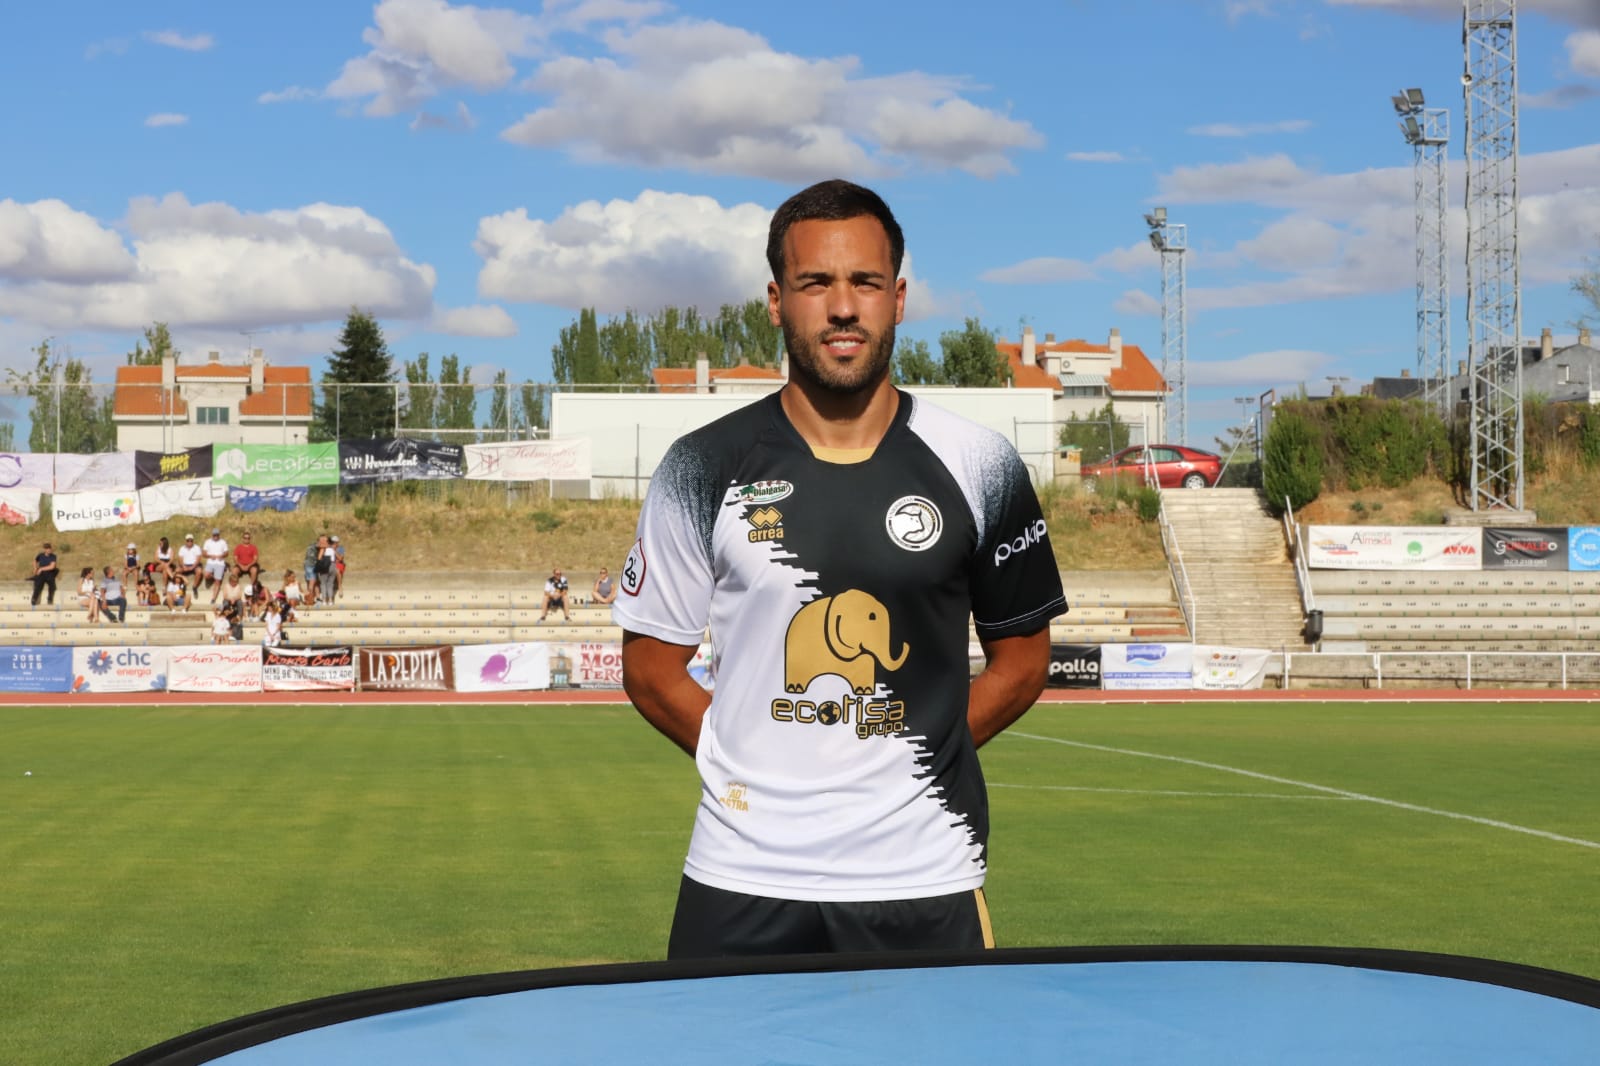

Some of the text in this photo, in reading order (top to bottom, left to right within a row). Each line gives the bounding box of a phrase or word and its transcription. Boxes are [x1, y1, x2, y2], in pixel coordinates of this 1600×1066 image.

[57, 508, 111, 521] ProLiga
[749, 527, 785, 542] errea
[116, 648, 152, 666] chc
[368, 650, 444, 682] LA PEPITA
[1049, 658, 1099, 676] palla
[772, 694, 905, 725] ecotisa
[856, 721, 904, 740] grupo
